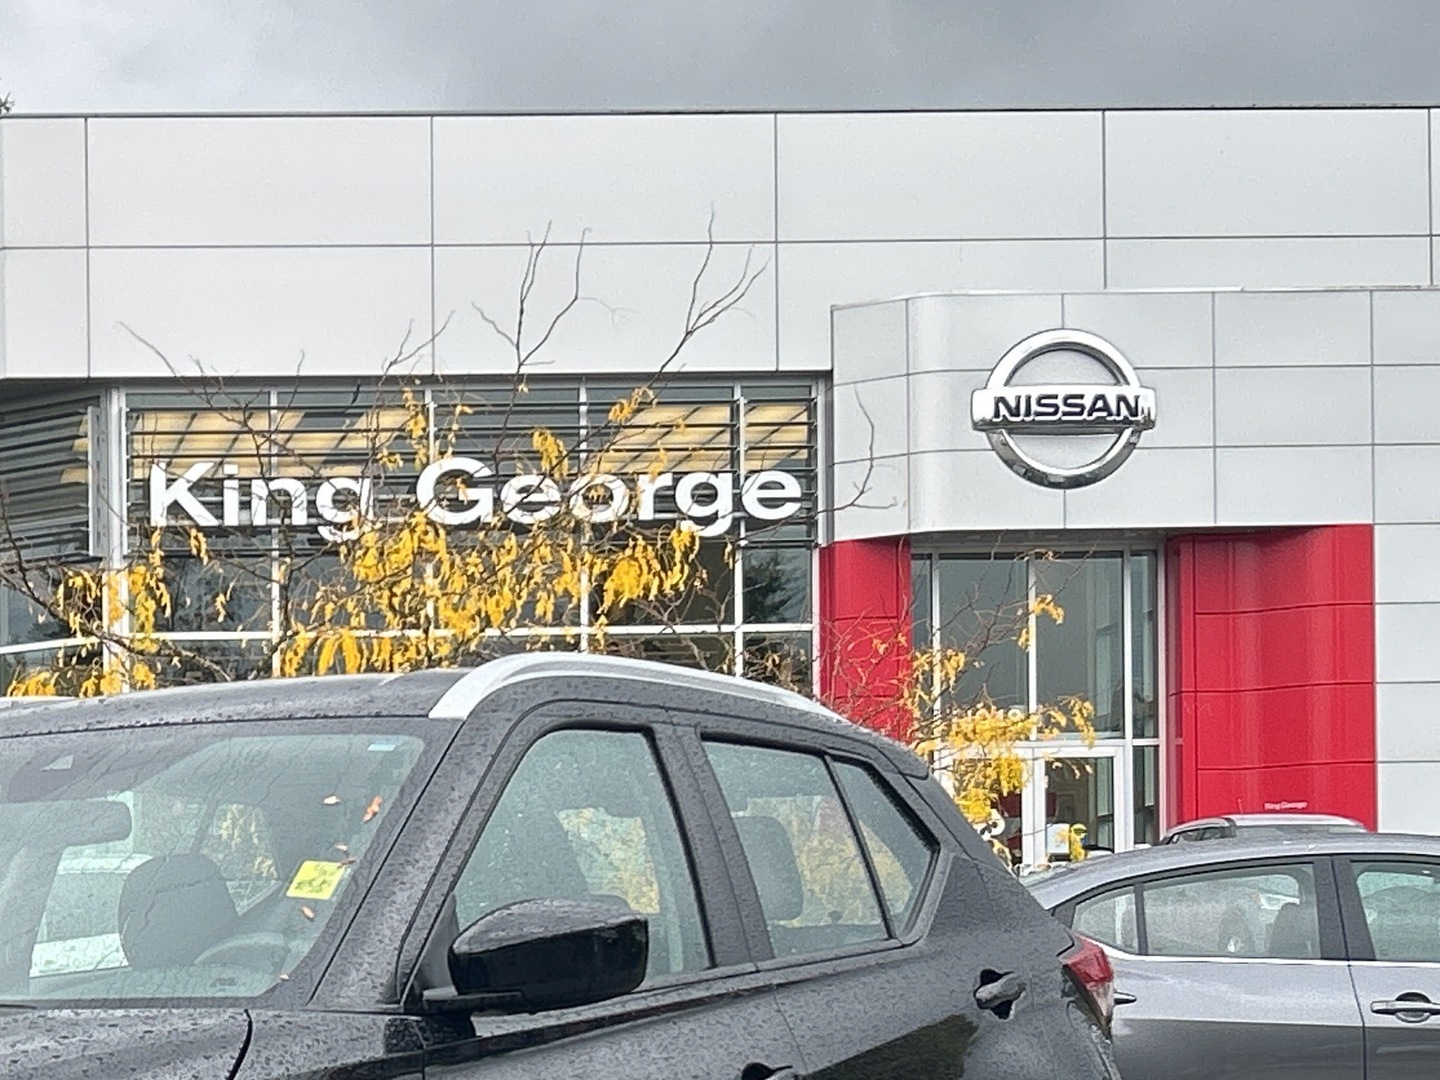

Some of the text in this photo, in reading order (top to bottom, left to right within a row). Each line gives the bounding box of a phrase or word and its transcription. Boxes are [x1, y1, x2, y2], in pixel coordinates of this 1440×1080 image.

[992, 393, 1140, 420] NISSAN
[149, 456, 803, 543] King George
